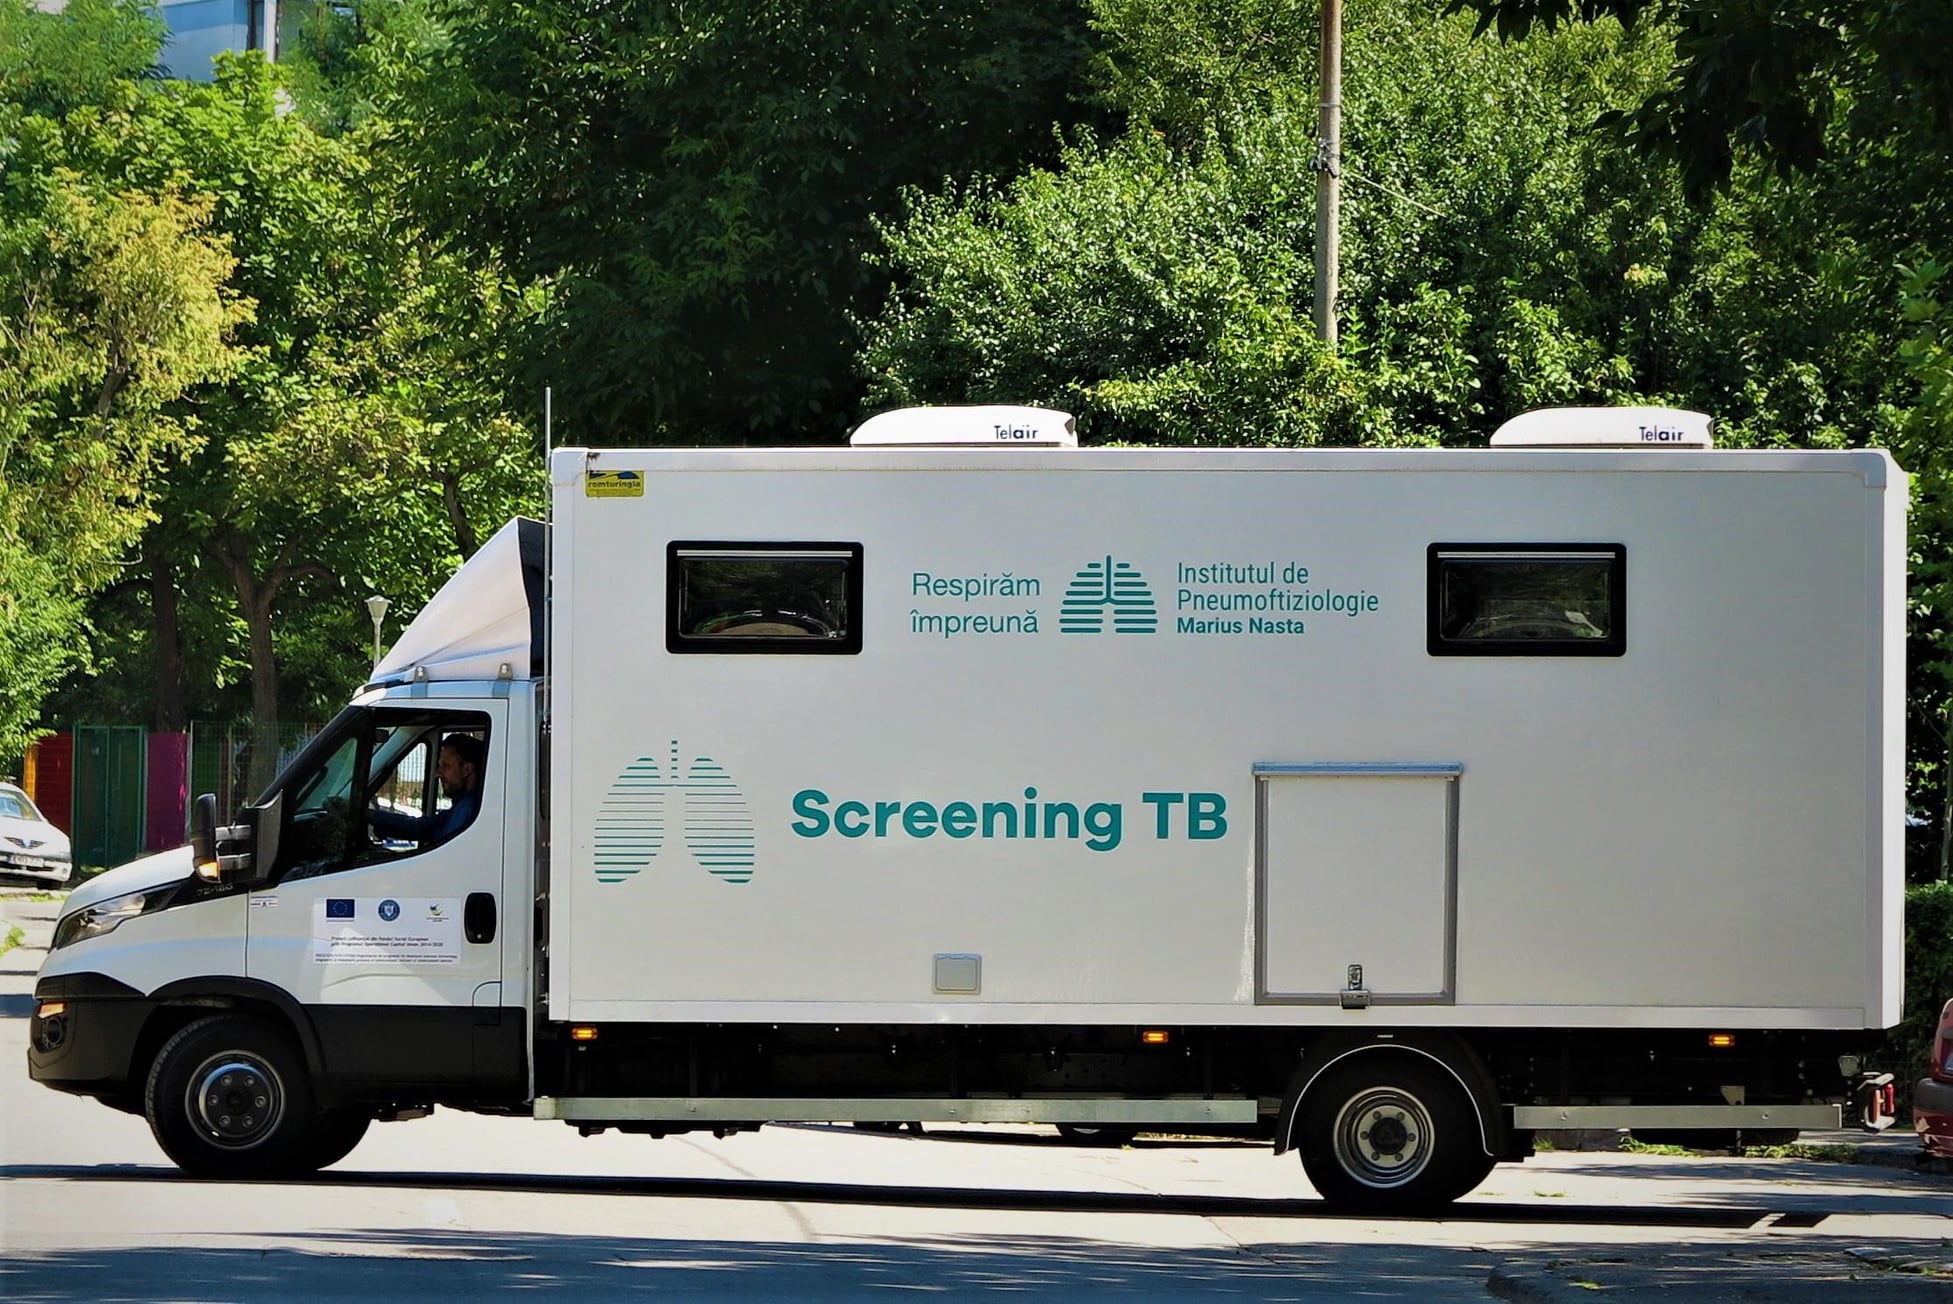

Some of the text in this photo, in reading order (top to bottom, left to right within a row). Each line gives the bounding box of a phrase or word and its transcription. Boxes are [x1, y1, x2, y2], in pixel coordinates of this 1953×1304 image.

[994, 424, 1038, 439] Telair
[1639, 425, 1684, 441] Telair
[1178, 561, 1309, 584] Institutul de
[912, 571, 1041, 601] Respirăm
[1177, 588, 1379, 617] Pneumoftiziologie
[910, 609, 1039, 638] împreună
[1177, 617, 1305, 635] Marius Nasta
[791, 786, 1228, 852] Screening TB
